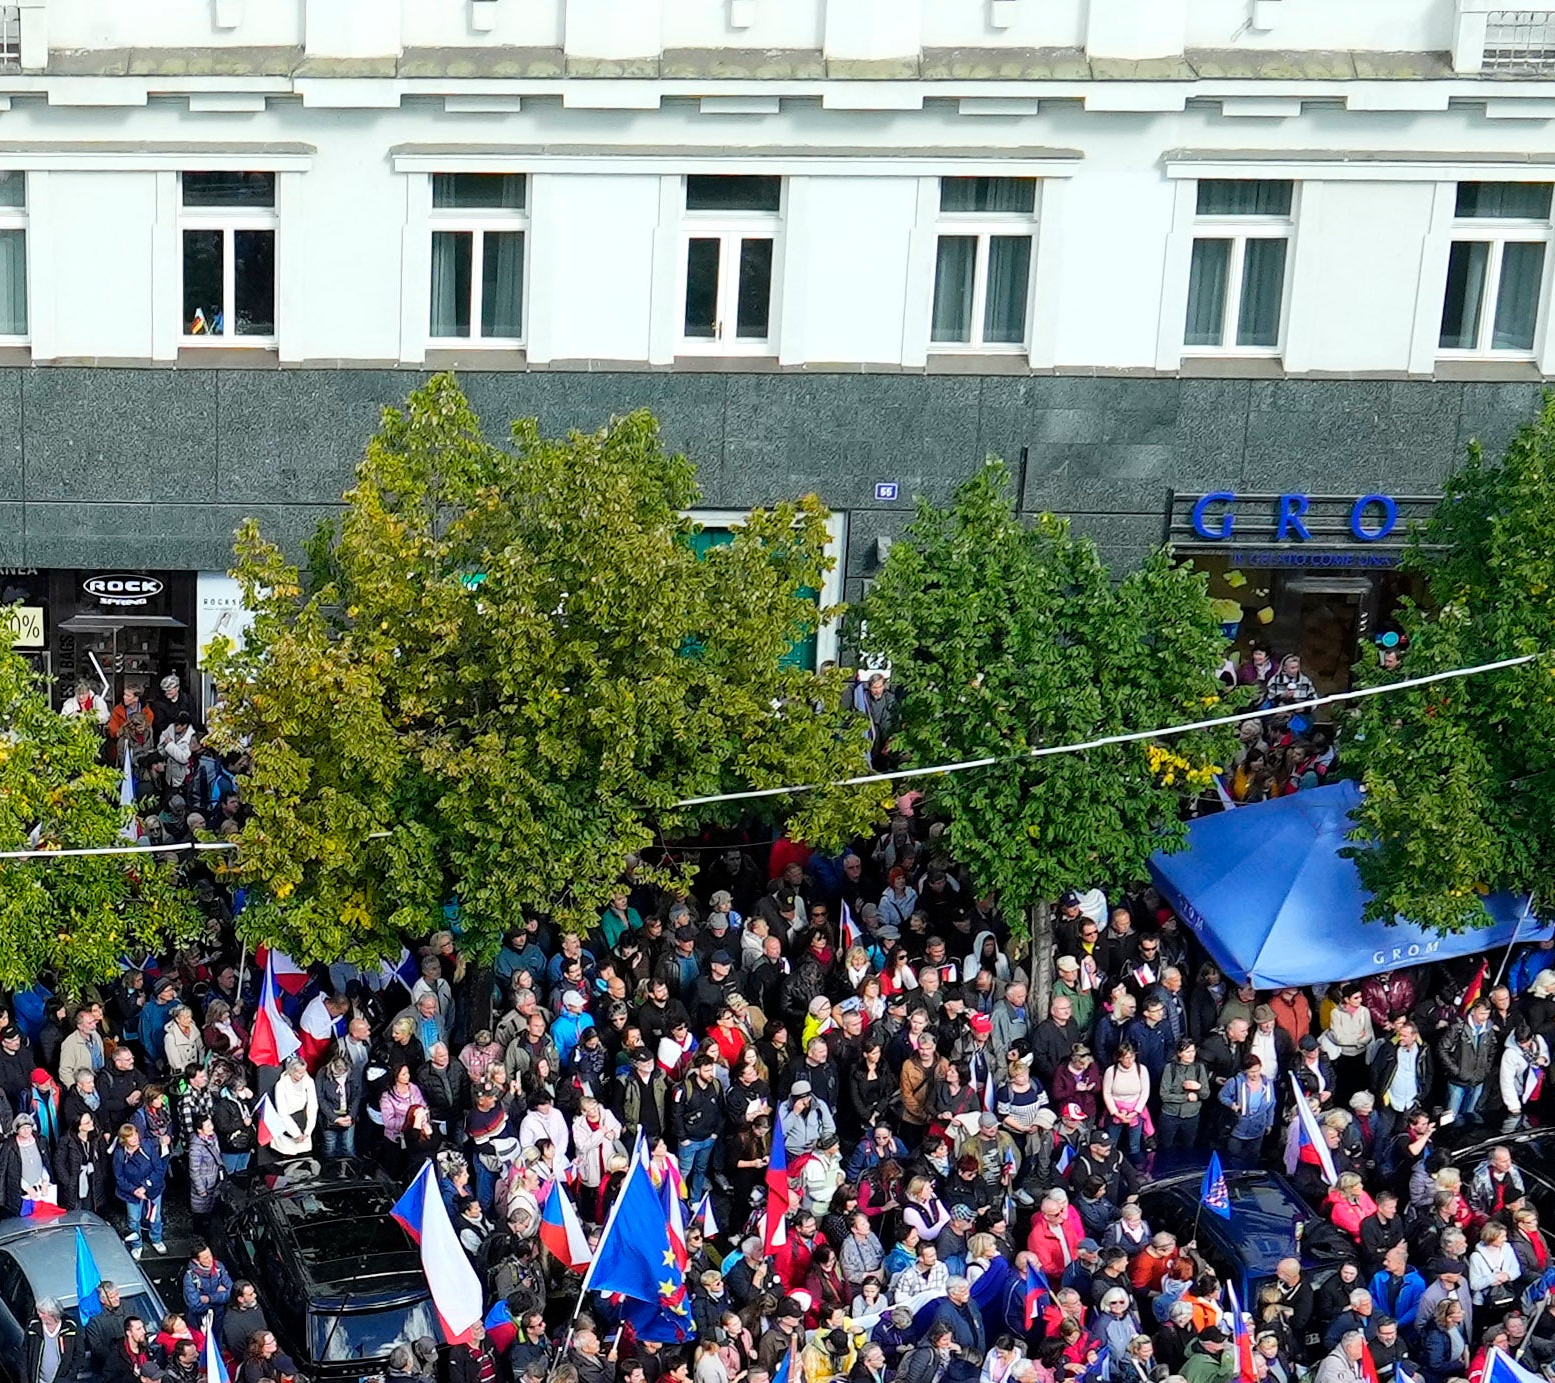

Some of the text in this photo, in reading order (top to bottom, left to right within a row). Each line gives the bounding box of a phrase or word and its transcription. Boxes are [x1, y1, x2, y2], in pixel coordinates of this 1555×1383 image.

[880, 486, 893, 497] 55
[1192, 492, 1398, 541] GRO
[89, 580, 156, 593] ROCK
[9, 615, 39, 639] 0%
[1373, 941, 1440, 965] GROM
